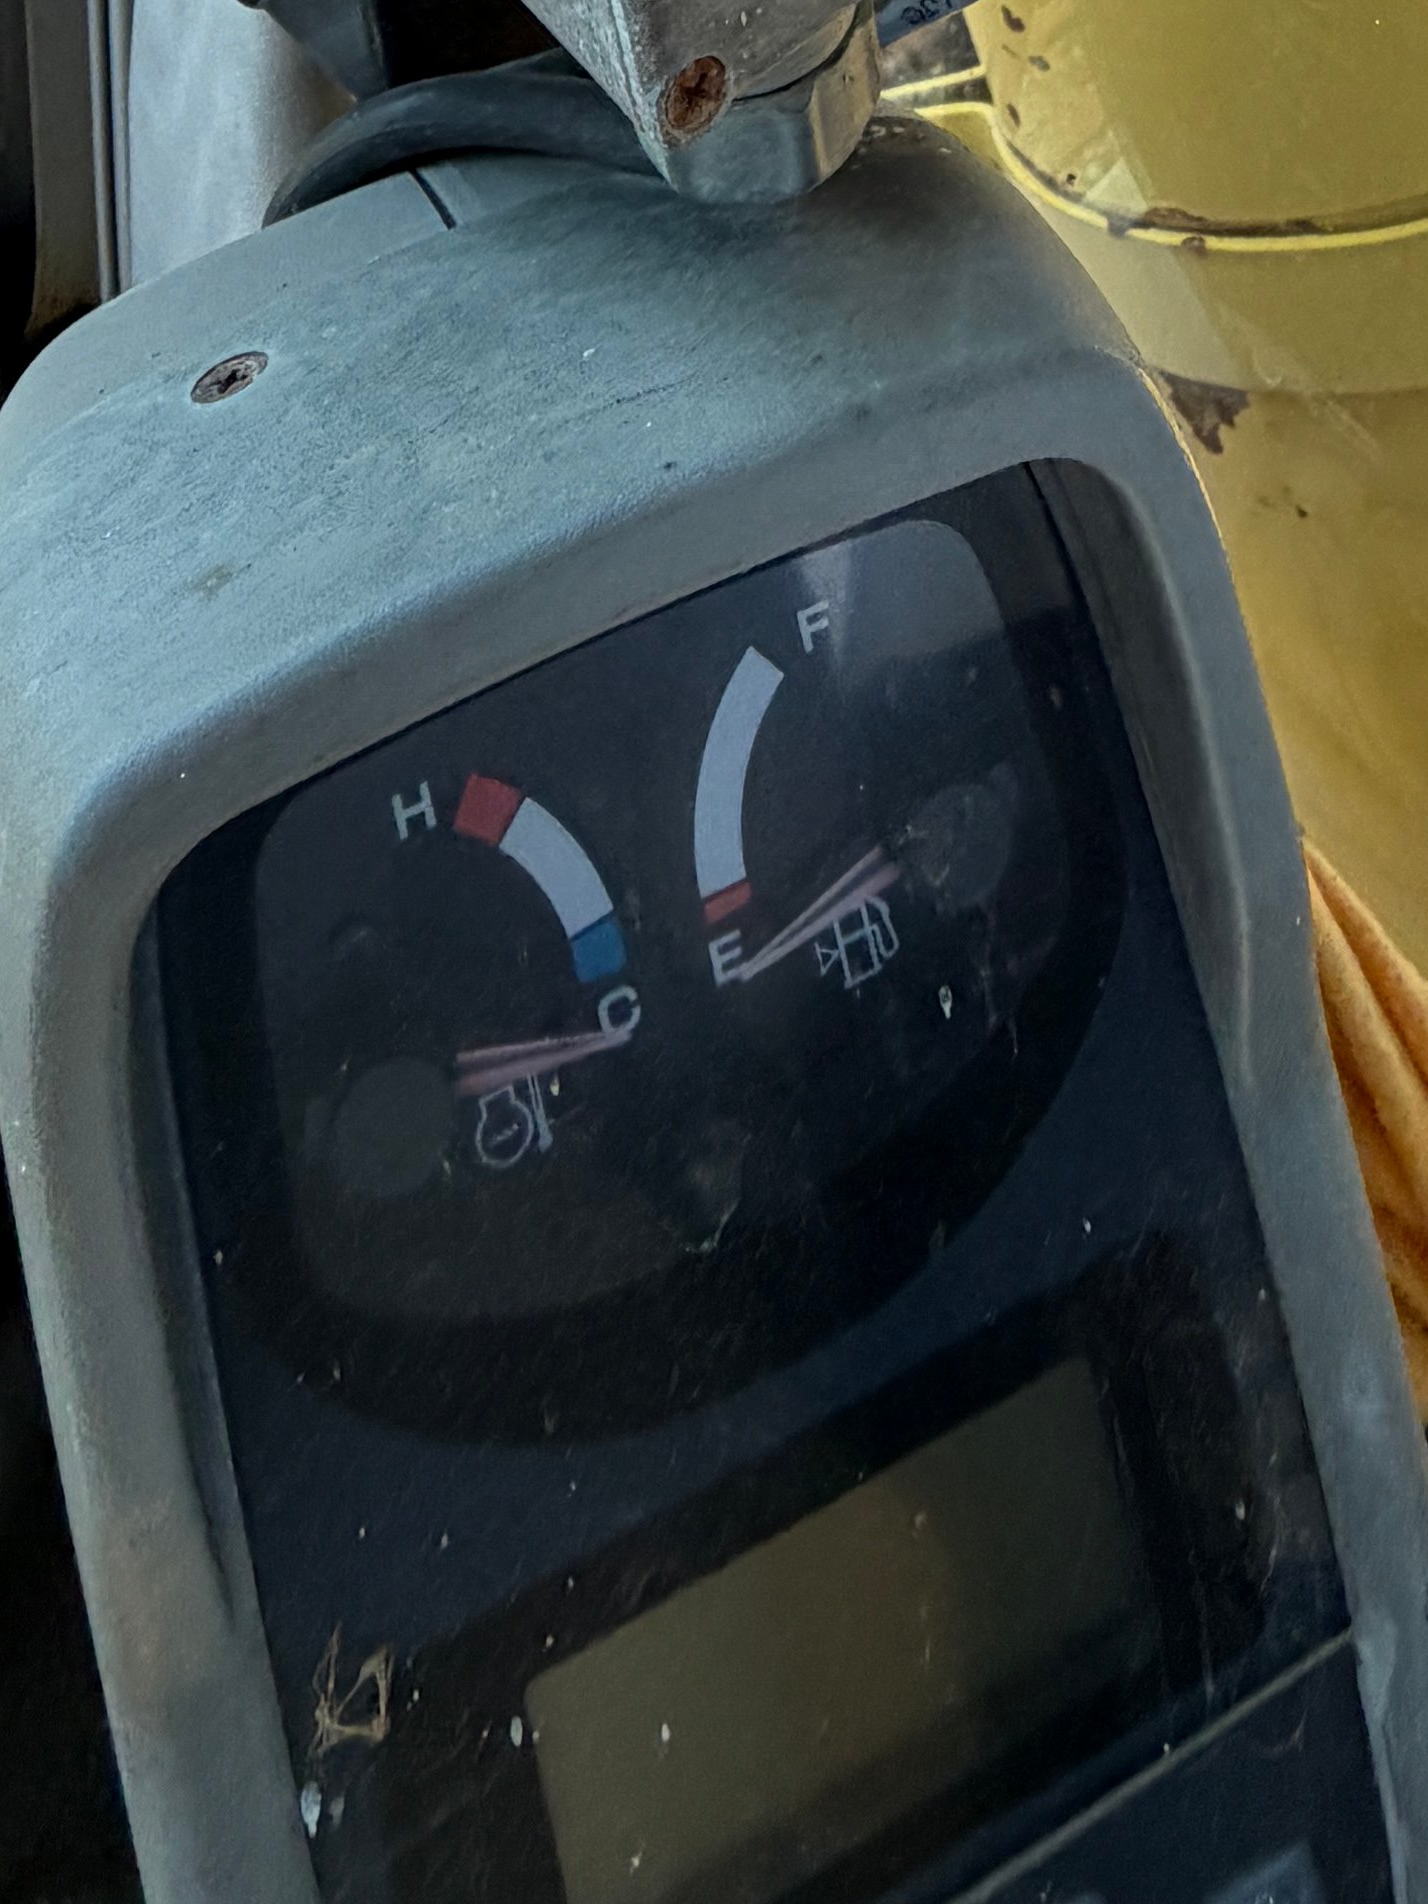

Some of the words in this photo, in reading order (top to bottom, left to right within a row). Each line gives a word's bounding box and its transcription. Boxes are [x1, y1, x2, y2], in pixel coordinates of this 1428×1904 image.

[796, 600, 830, 653] F
[391, 781, 437, 840] H
[708, 928, 743, 988] E
[597, 984, 642, 1036] C
